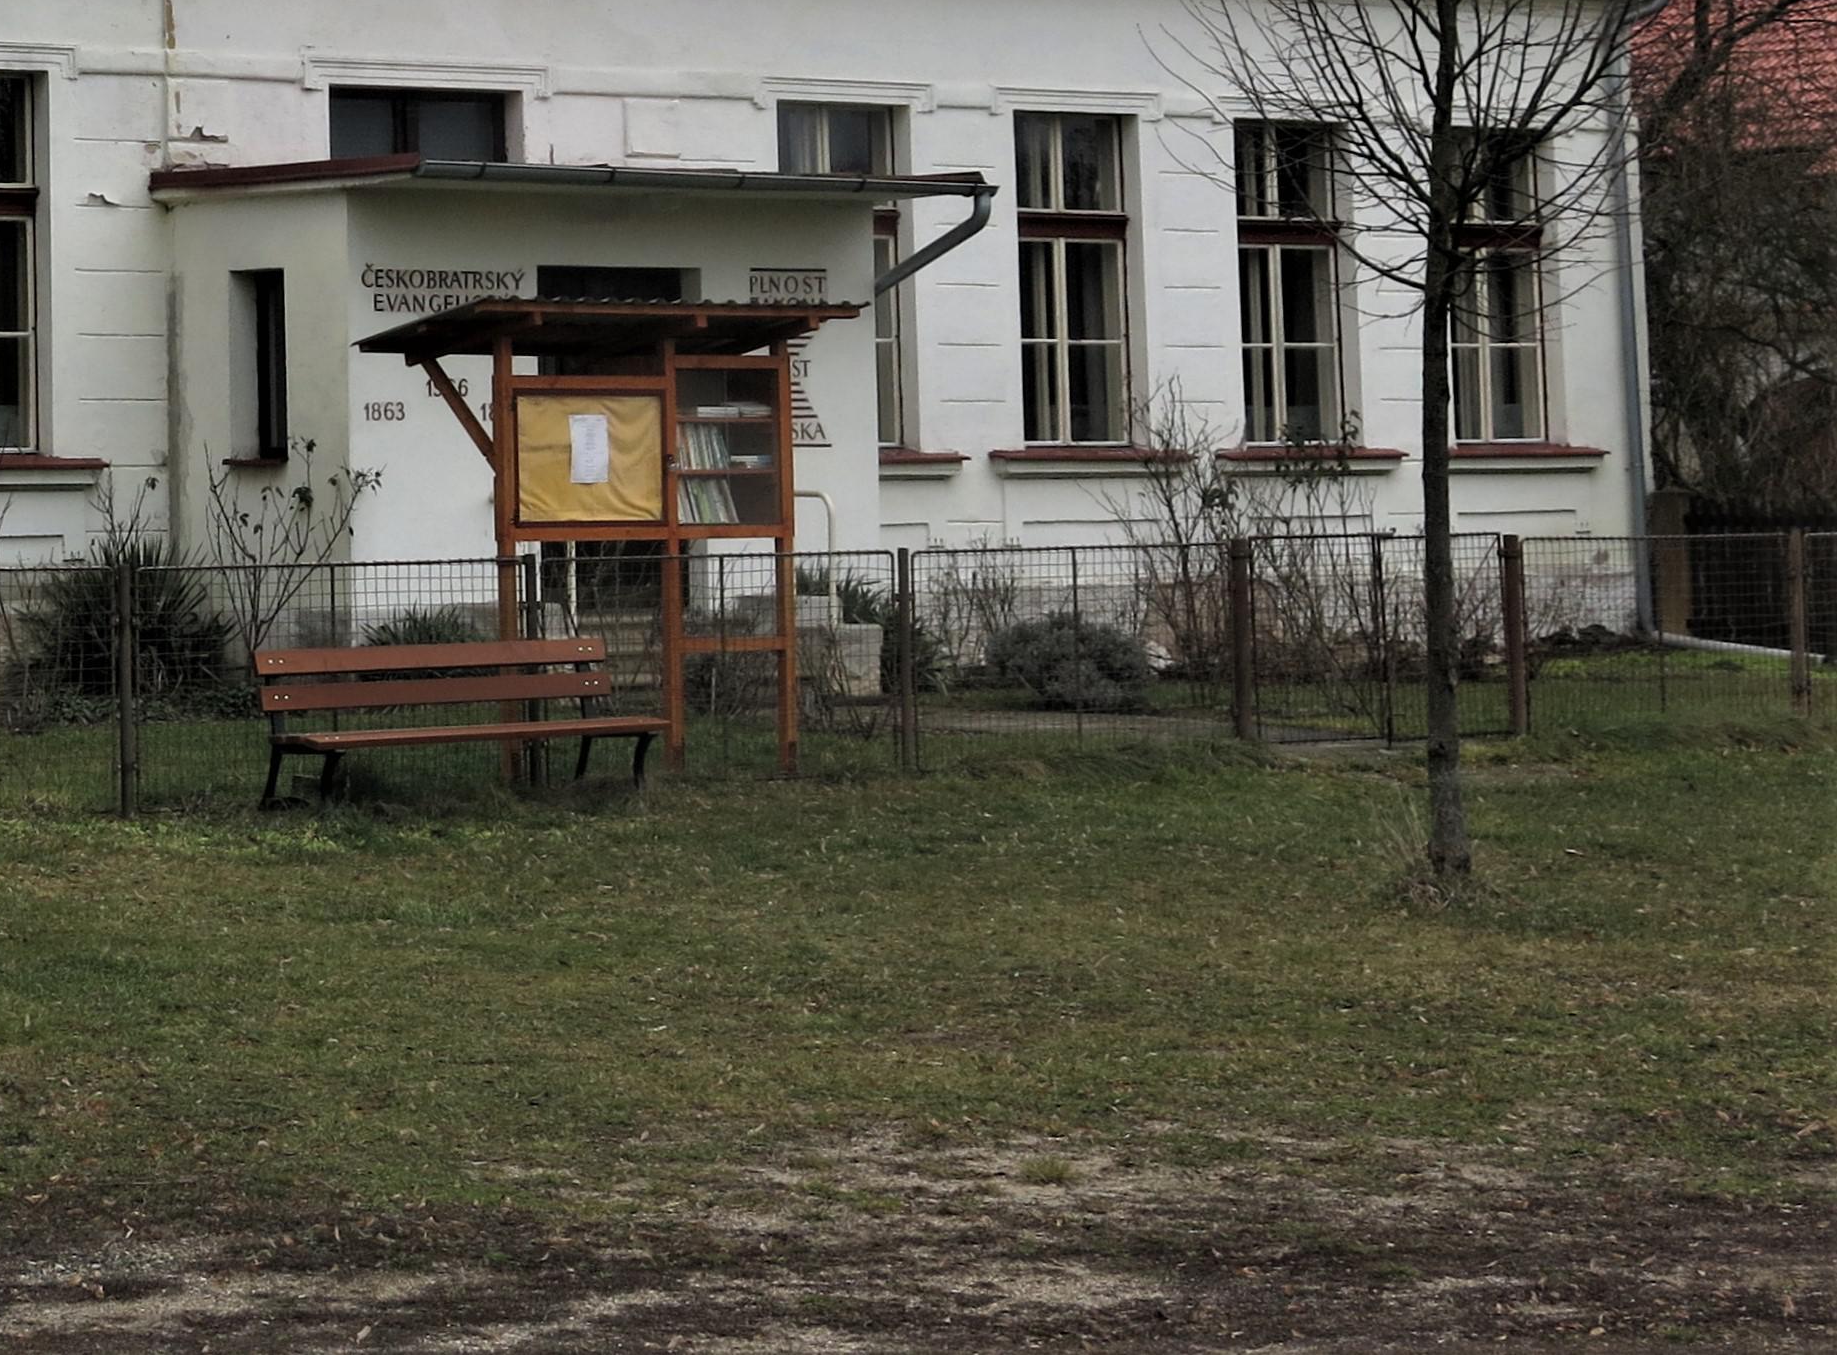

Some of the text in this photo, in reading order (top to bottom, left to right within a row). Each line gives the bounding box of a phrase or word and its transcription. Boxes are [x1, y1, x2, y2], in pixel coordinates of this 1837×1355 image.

[361, 262, 525, 290] ČESKOBRATRSKÝ
[749, 275, 827, 294] PLNOST
[792, 360, 811, 378] ST
[426, 378, 469, 397] 16
[363, 401, 406, 421] 1863
[791, 422, 827, 440] SKA
